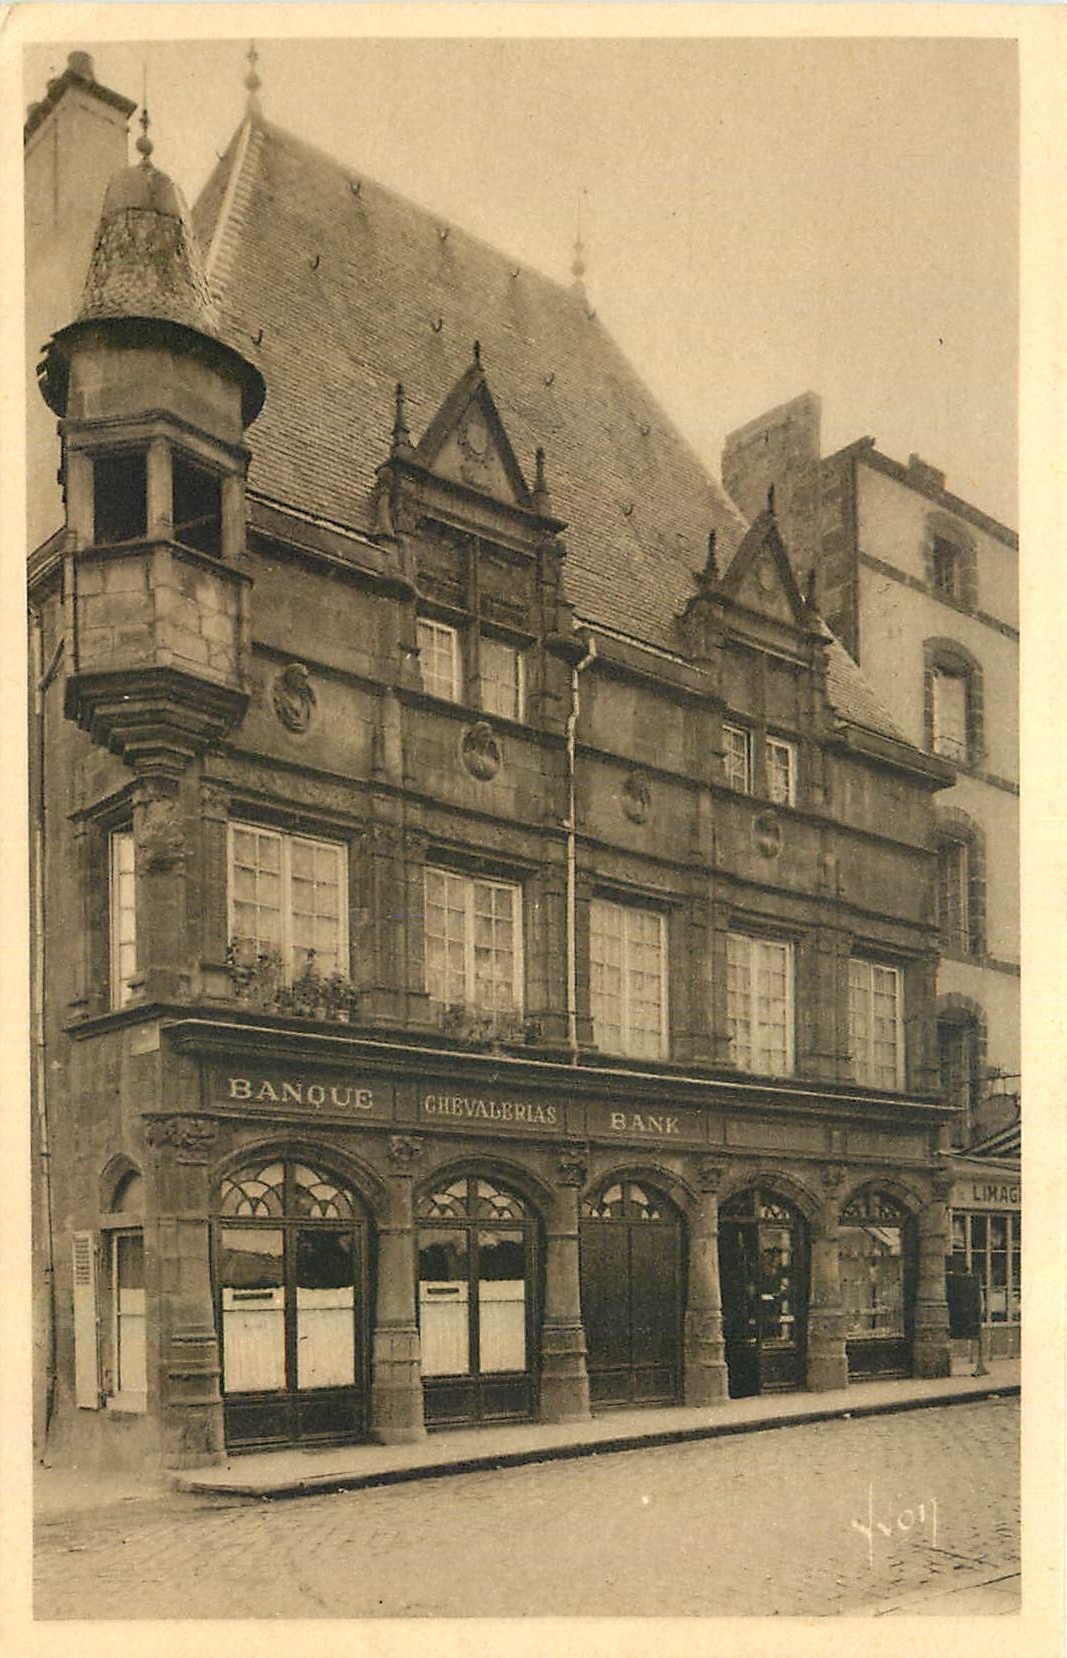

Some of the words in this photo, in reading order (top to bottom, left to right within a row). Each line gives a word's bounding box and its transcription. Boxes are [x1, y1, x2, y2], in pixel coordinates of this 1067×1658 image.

[228, 1078, 375, 1109] BANQUE
[424, 1094, 557, 1125] CHEVALERIAS
[610, 1112, 681, 1134] BANK
